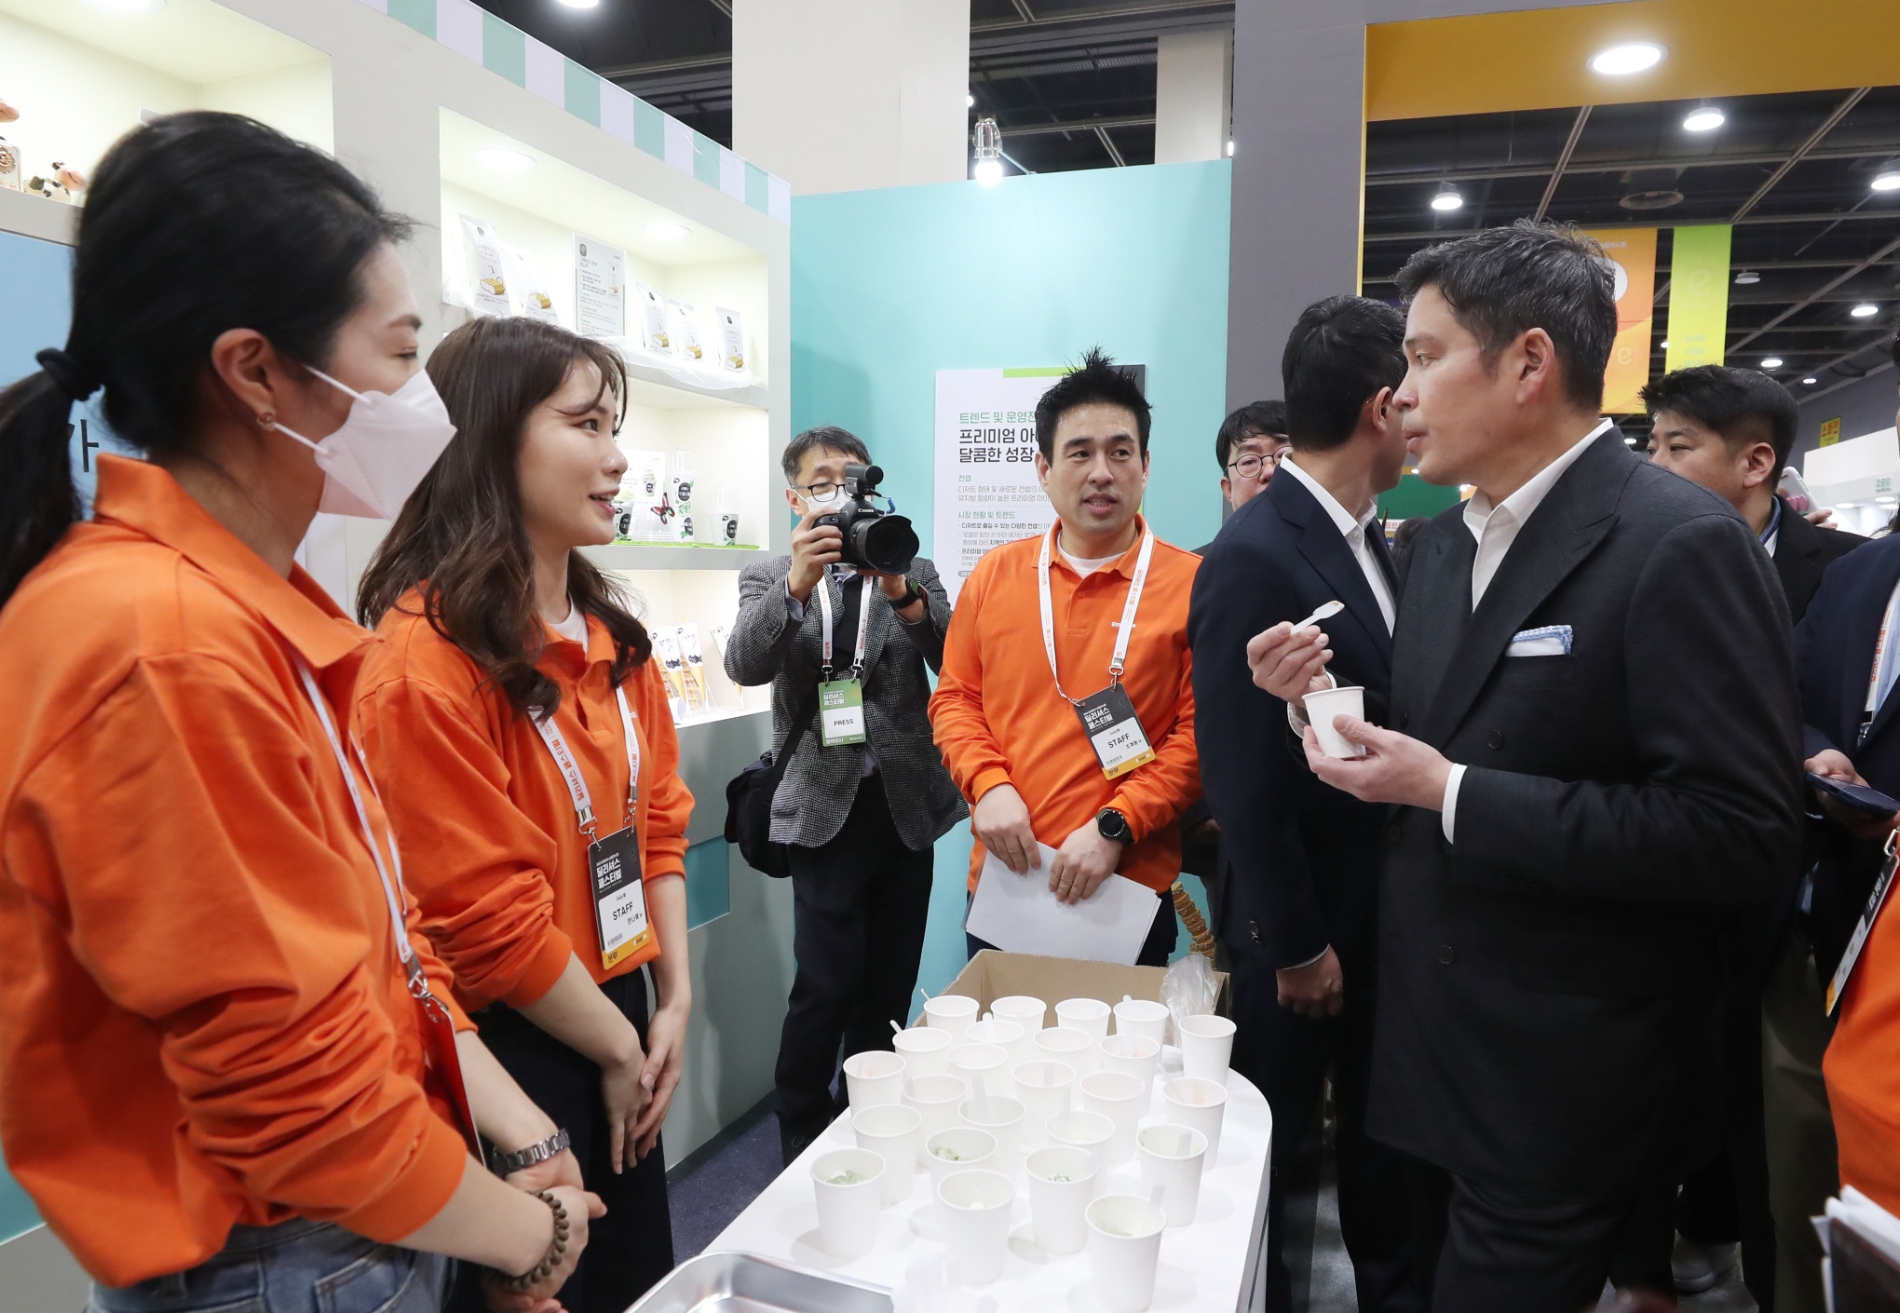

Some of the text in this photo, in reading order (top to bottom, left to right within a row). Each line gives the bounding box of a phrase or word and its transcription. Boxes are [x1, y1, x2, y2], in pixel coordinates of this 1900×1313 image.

[959, 412, 990, 424] 트렌드
[994, 412, 1003, 423] 및
[959, 428, 1015, 444] 프리미엄
[960, 447, 1034, 463] 달콤한 성장
[1108, 733, 1130, 749] STAFF
[569, 770, 585, 801] 딜리셔스
[597, 858, 621, 879] 딜리셔스
[612, 901, 634, 920] STAFF
